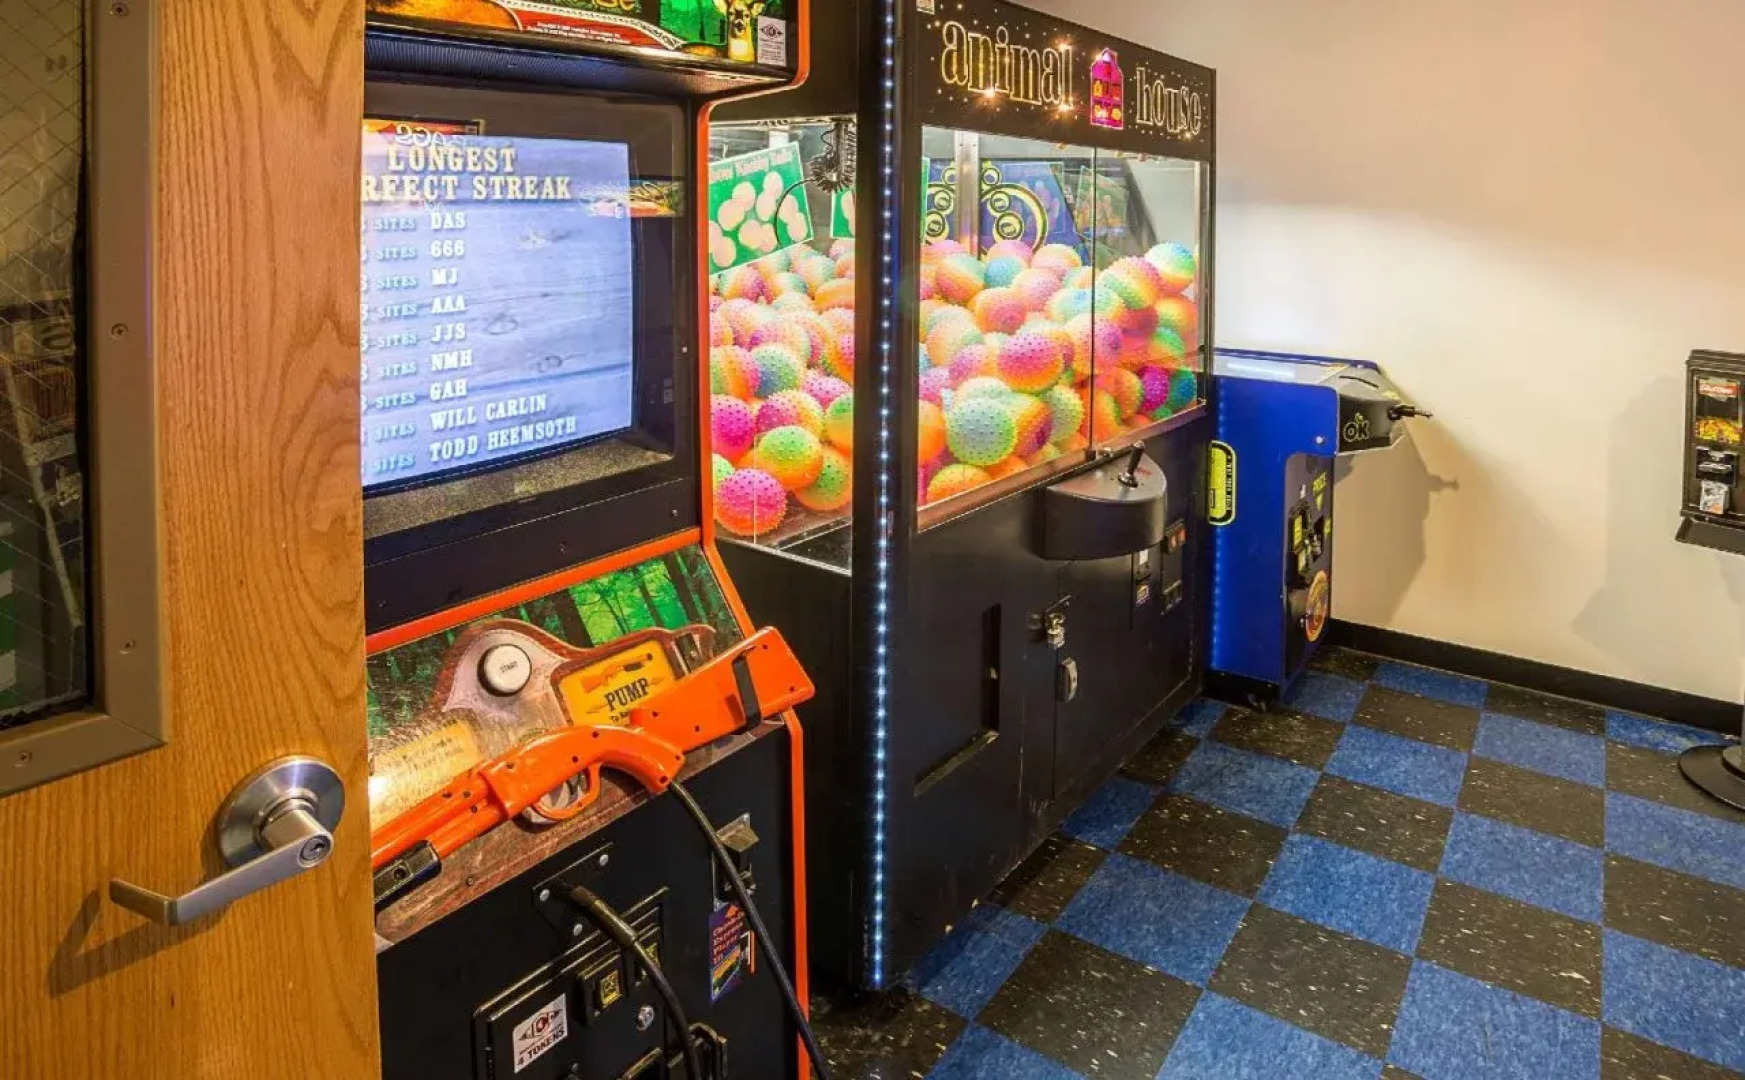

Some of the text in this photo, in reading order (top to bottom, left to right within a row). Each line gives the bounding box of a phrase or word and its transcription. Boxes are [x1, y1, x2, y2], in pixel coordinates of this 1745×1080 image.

[941, 20, 1202, 136] animal house
[387, 144, 517, 173] LONGEST
[362, 175, 572, 202] RFECT STREAK
[430, 211, 466, 230] DAS
[430, 239, 465, 258] 666
[430, 267, 459, 286] MJ
[431, 294, 466, 314] AAA
[430, 322, 466, 343] JJS
[430, 348, 473, 372] NMH
[430, 405, 477, 431] WILL
[485, 393, 547, 421] CARLIN
[429, 435, 478, 462] TODD
[486, 415, 577, 450] HEEMSOTH
[499, 660, 518, 674] START
[604, 677, 650, 712] PUMP
[527, 1026, 566, 1060] TOKENS
